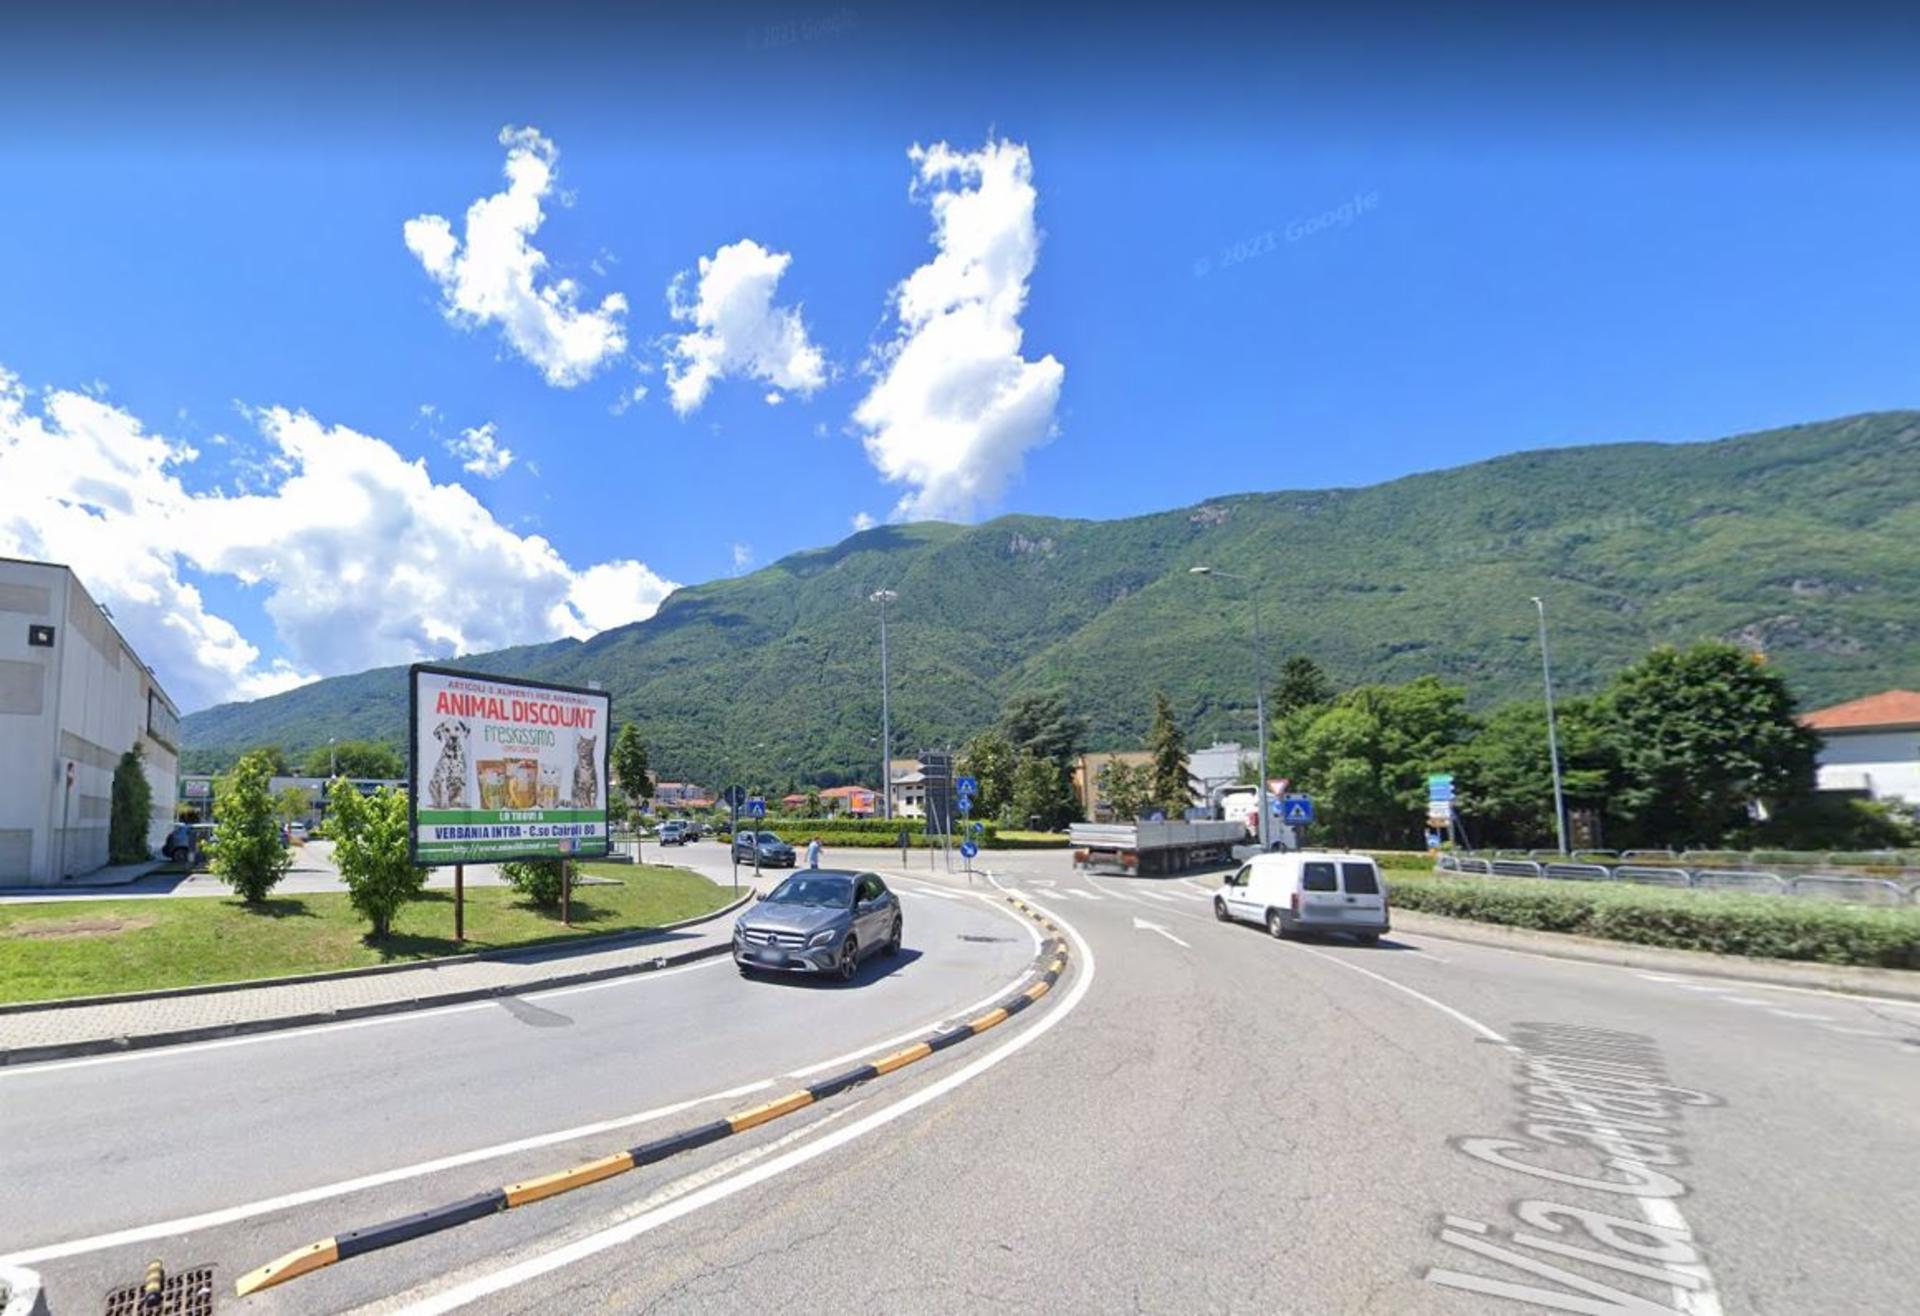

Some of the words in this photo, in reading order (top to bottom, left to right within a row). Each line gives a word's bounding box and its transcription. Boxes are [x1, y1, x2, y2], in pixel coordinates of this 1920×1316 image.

[436, 691, 509, 721] ANIMAL
[512, 700, 597, 729] DISCOUNT
[435, 827, 489, 839] VERBANIA
[491, 826, 522, 838] INTRA
